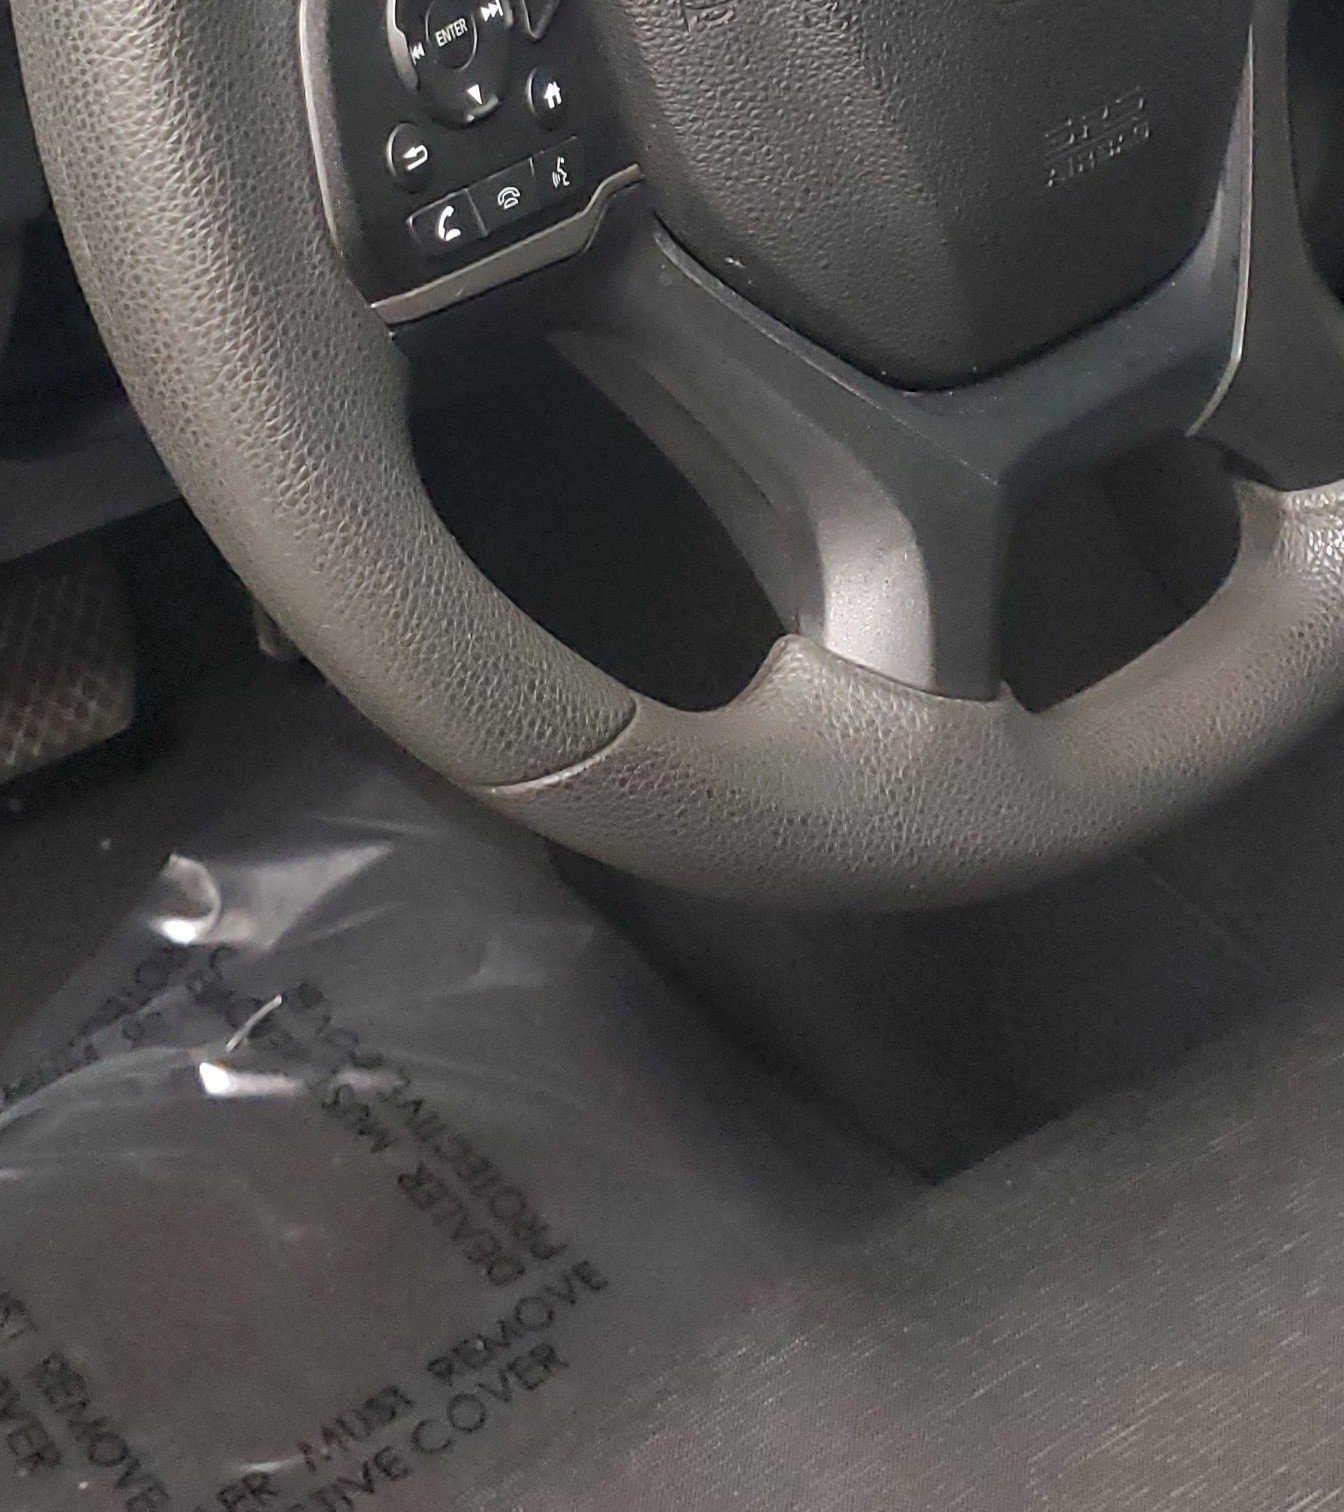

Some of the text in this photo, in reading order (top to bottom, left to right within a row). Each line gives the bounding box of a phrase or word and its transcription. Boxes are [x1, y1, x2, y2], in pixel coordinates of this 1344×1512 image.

[435, 17, 468, 48] ENTER
[427, 1259, 608, 1386] REMOVE
[412, 1341, 572, 1454] COVER
